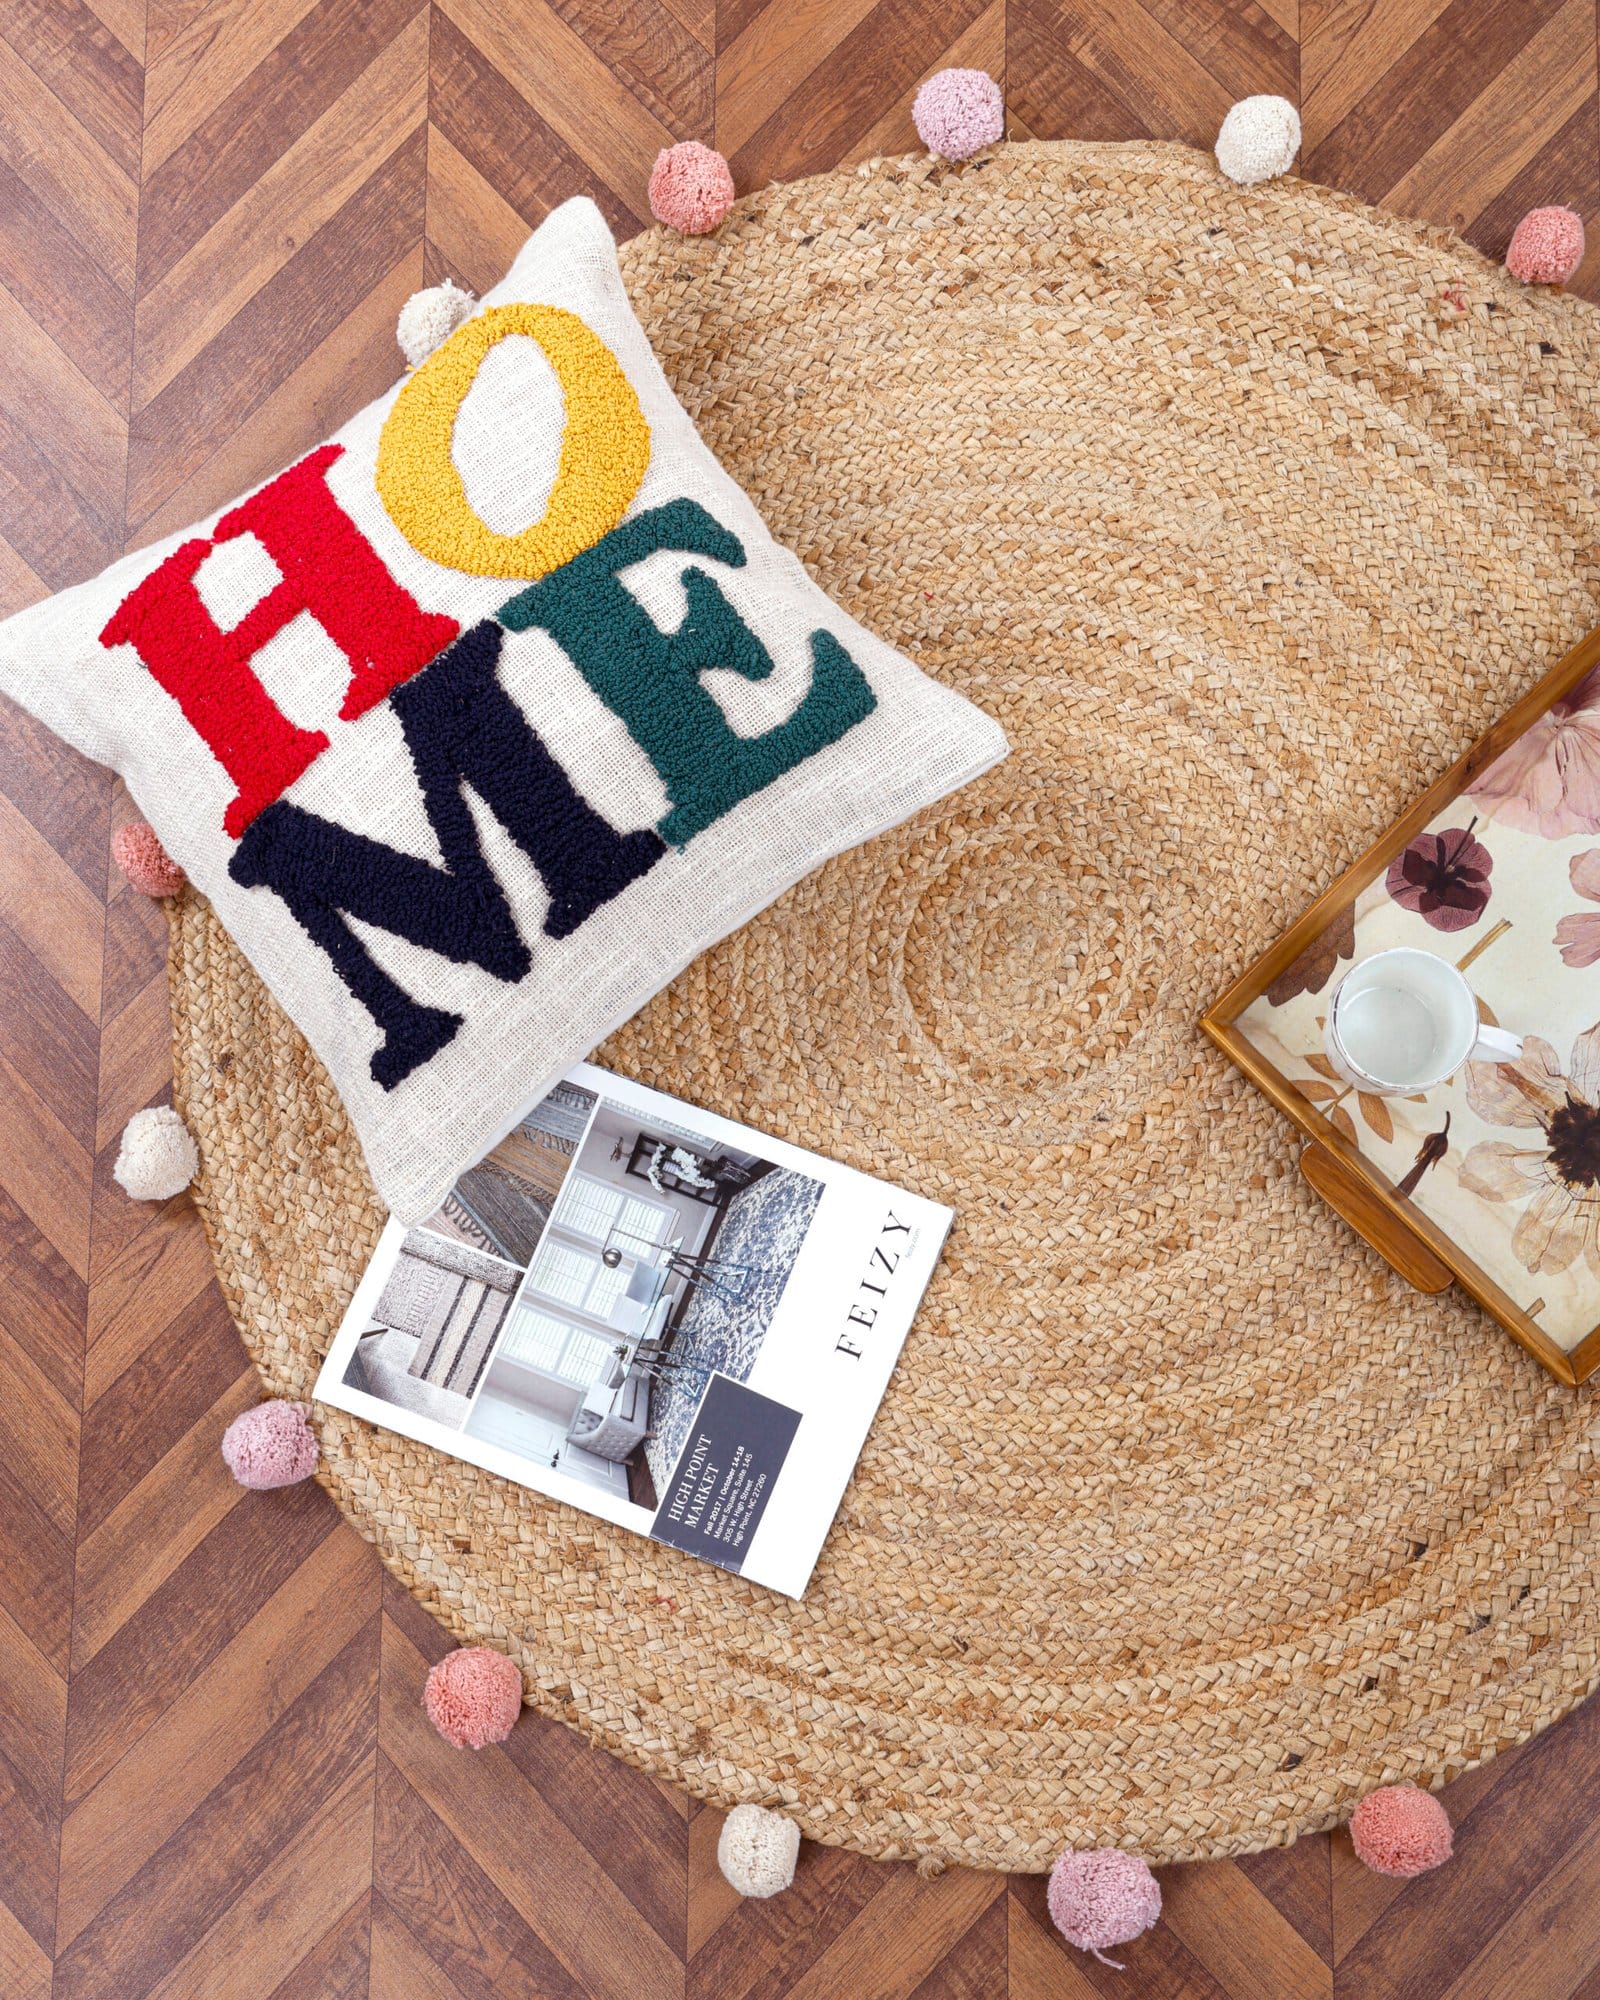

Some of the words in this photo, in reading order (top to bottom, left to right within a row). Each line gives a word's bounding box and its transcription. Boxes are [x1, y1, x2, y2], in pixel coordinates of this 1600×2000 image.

[834, 1209, 912, 1361] FEIZY
[667, 1481, 693, 1522] HIGH
[685, 1433, 712, 1480] POINT
[684, 1463, 720, 1528] MARKET
[704, 1520, 714, 1535] Fall
[709, 1501, 722, 1522] 2017
[720, 1468, 736, 1496] October
[731, 1445, 745, 1468] 14-18
[713, 1515, 728, 1539] Market
[723, 1488, 739, 1514] Square,
[734, 1469, 747, 1488] Suite
[742, 1453, 753, 1470] 145
[748, 1497, 758, 1511] NC
[752, 1473, 767, 1498] 27260
[723, 1526, 734, 1543] 305
[733, 1500, 746, 1518] High
[741, 1479, 754, 1501] Street
[732, 1528, 744, 1547] High
